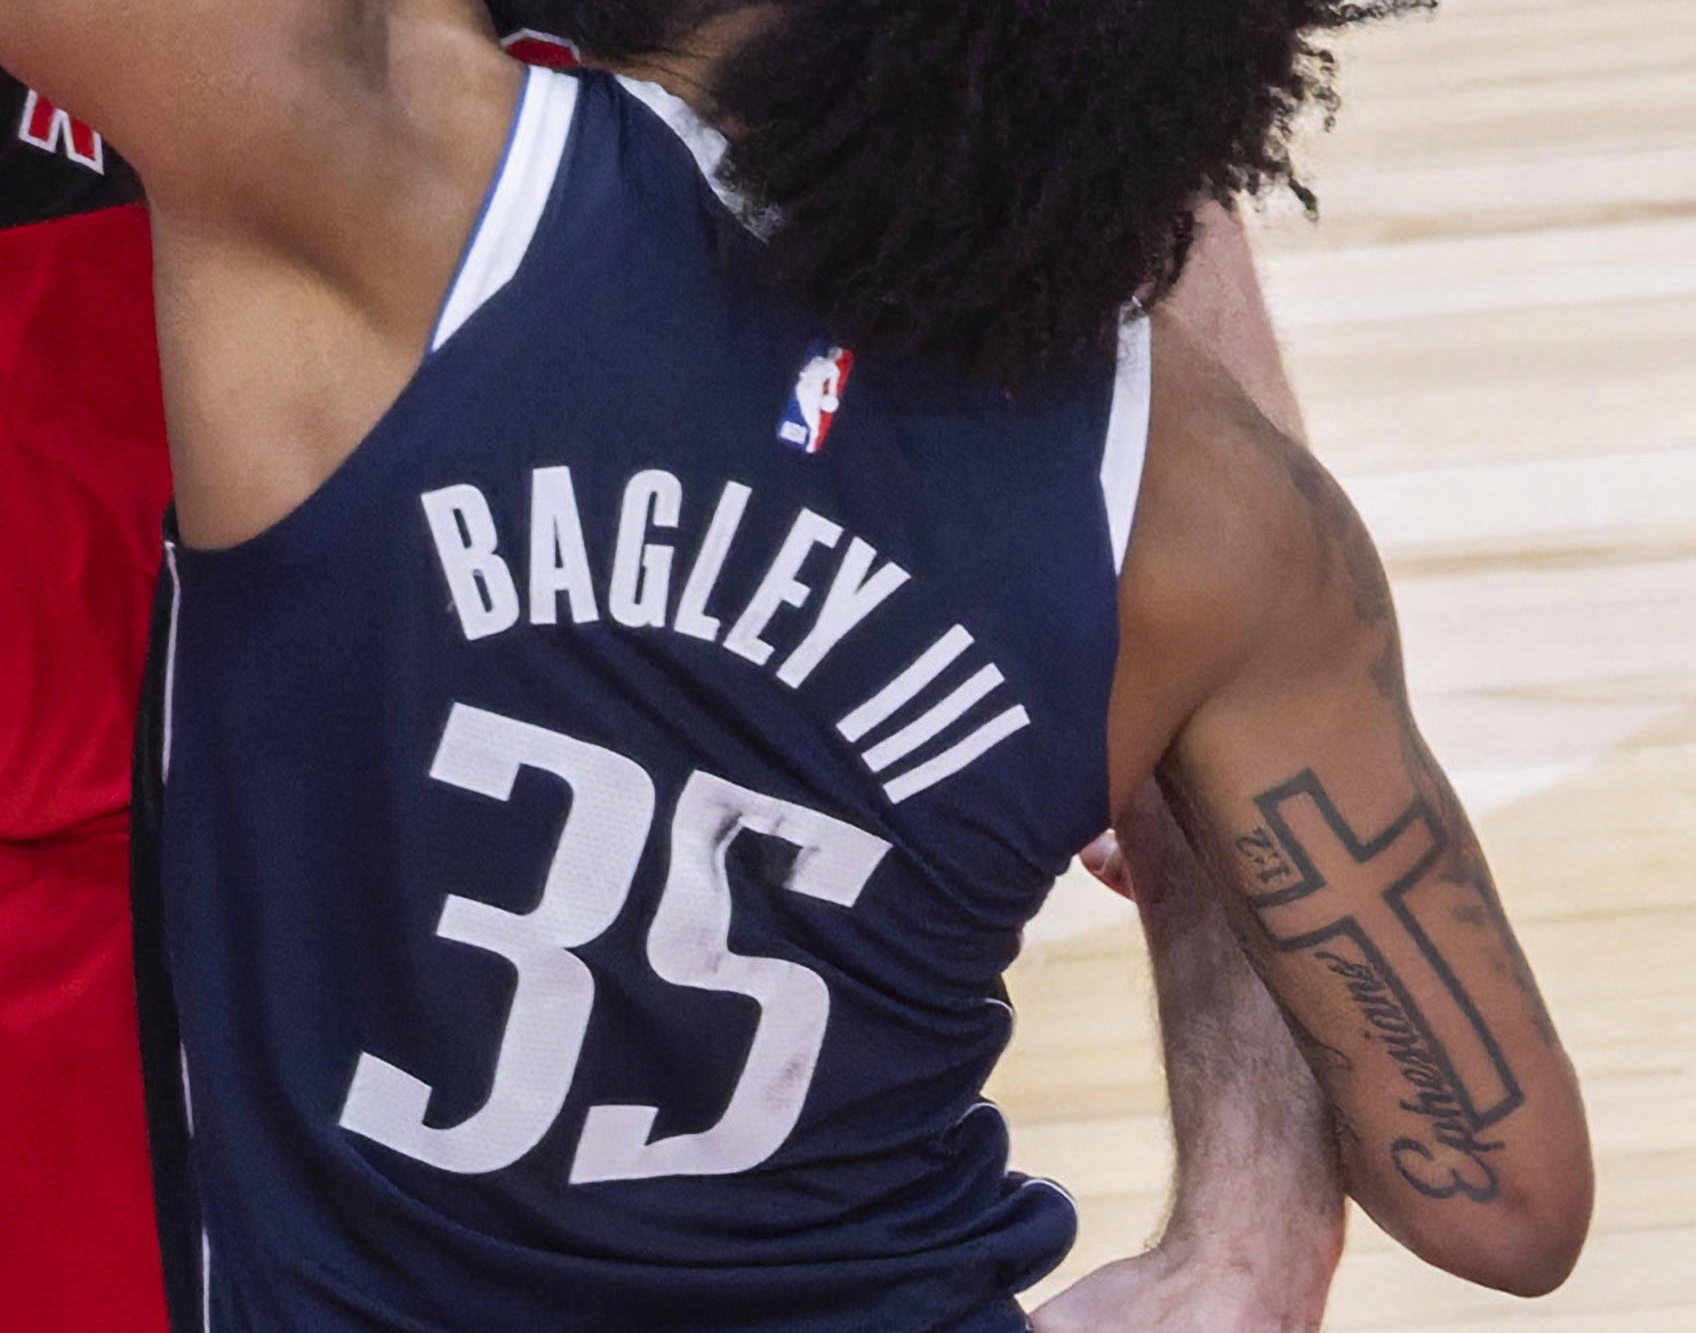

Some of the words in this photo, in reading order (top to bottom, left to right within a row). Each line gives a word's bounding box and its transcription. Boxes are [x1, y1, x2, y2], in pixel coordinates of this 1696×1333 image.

[420, 465, 911, 689] BAGLEY
[836, 623, 1031, 805] III
[338, 701, 893, 1186] 35
[1315, 950, 1505, 1204] Ephesians
